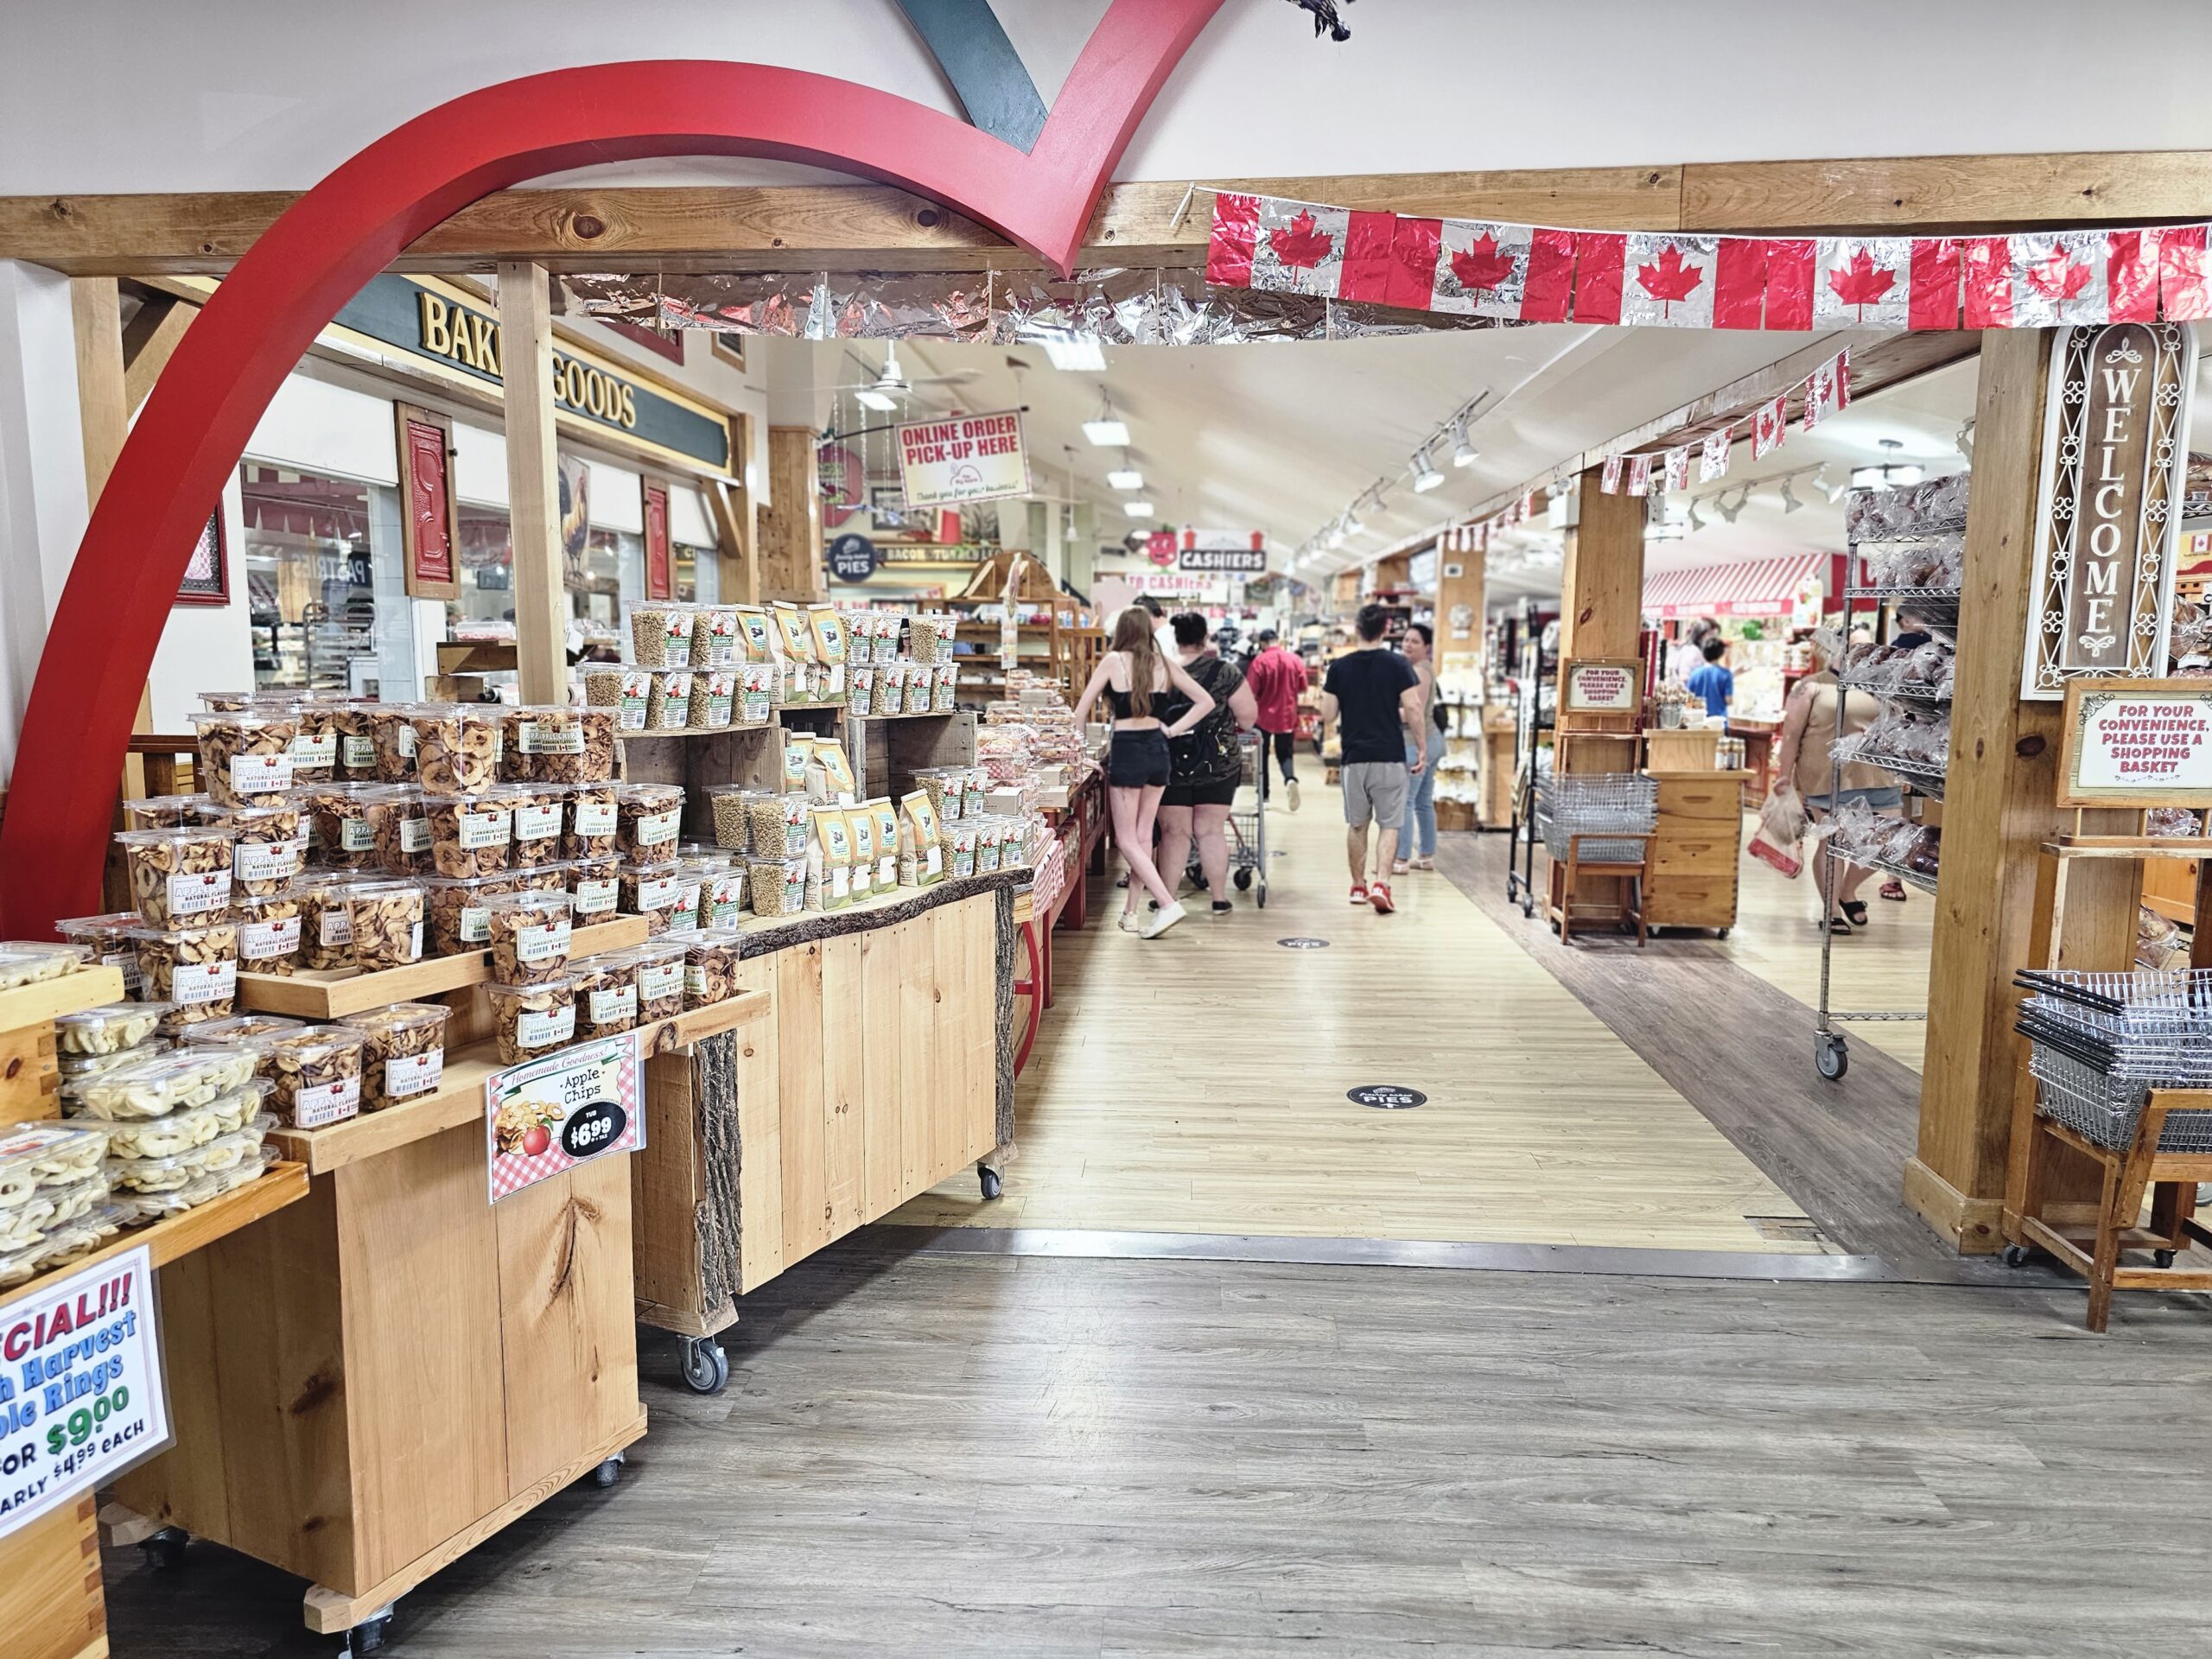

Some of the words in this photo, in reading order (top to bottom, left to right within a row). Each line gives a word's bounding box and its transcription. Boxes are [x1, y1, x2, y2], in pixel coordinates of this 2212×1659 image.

[420, 291, 504, 377] BAK
[551, 348, 636, 429] GOODS
[901, 423, 959, 447] ONLINE
[962, 415, 1017, 439] ORDER
[906, 442, 974, 466] PICK-UP
[977, 435, 1019, 457] HERE
[2083, 368, 2142, 633] WELCOME
[887, 549, 926, 561] BACON
[1182, 553, 1263, 568] CASHIERS
[836, 561, 870, 575] PIES
[1128, 576, 1144, 589] TO
[2119, 705, 2148, 717] FOR
[2152, 706, 2194, 717] YOUR
[2099, 719, 2209, 733] CONVENIENCE,
[2101, 734, 2157, 745] PLEASE
[2160, 734, 2189, 745] USE
[2191, 734, 2202, 745] A
[2111, 747, 2190, 760] SHOPPING
[2120, 761, 2178, 773] BASKET
[349, 826, 371, 835] APPL
[408, 827, 429, 836] APPL
[243, 855, 276, 865] APPLE
[175, 886, 209, 898] APPLE
[327, 921, 346, 931] APP
[468, 917, 487, 926] APP
[246, 931, 278, 943] APPLE
[179, 976, 214, 987] APPLE
[530, 1024, 555, 1033] CINNAMON
[512, 1059, 559, 1086] Homemade
[562, 1046, 608, 1068] Goodness!
[391, 1067, 422, 1079] APPLE
[564, 1068, 600, 1089] Apple
[400, 1075, 423, 1084] NATURAL
[564, 1084, 601, 1104] Chips
[302, 1094, 337, 1110] APPLE
[312, 1103, 338, 1114] NATURAL
[585, 1110, 597, 1119] TUB
[0, 1272, 132, 1363] CIAL!!!
[22, 1310, 137, 1394] Harvest
[44, 1354, 124, 1416] Rings
[0, 1442, 36, 1476] OR
